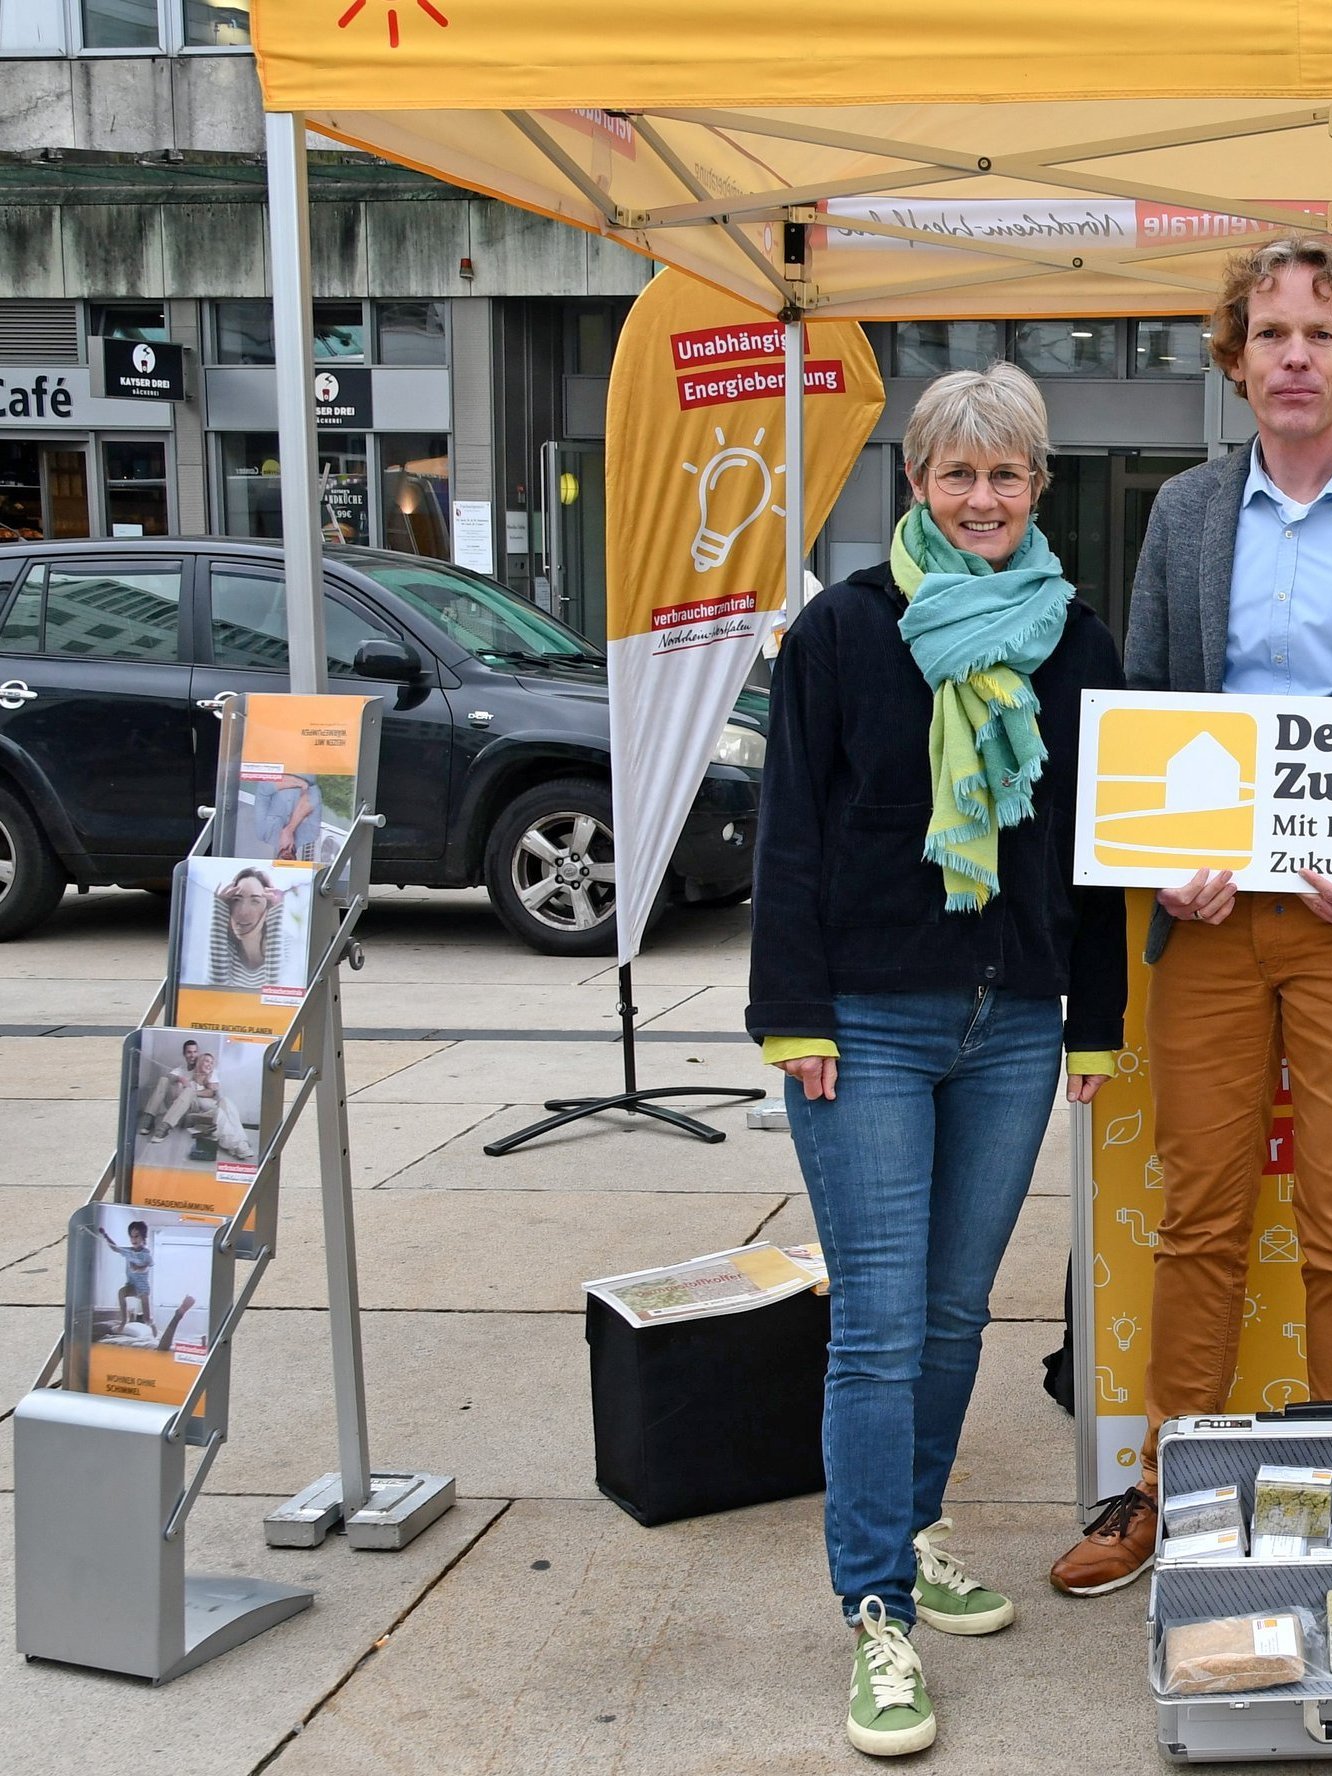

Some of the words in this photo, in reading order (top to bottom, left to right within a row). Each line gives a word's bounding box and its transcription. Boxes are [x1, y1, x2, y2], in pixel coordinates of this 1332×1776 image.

[677, 328, 787, 360] Unabhängig
[119, 376, 151, 387] KAYSER
[151, 379, 170, 388] DREI
[683, 370, 838, 401] Energieberung
[0, 375, 73, 418] afé
[315, 407, 333, 416] SER
[334, 407, 355, 416] DREI
[324, 494, 363, 505] ANDKÜCHE
[653, 595, 755, 626] verbraucherzentrale
[1272, 814, 1318, 837] Mit
[191, 1022, 219, 1031] FENSTER
